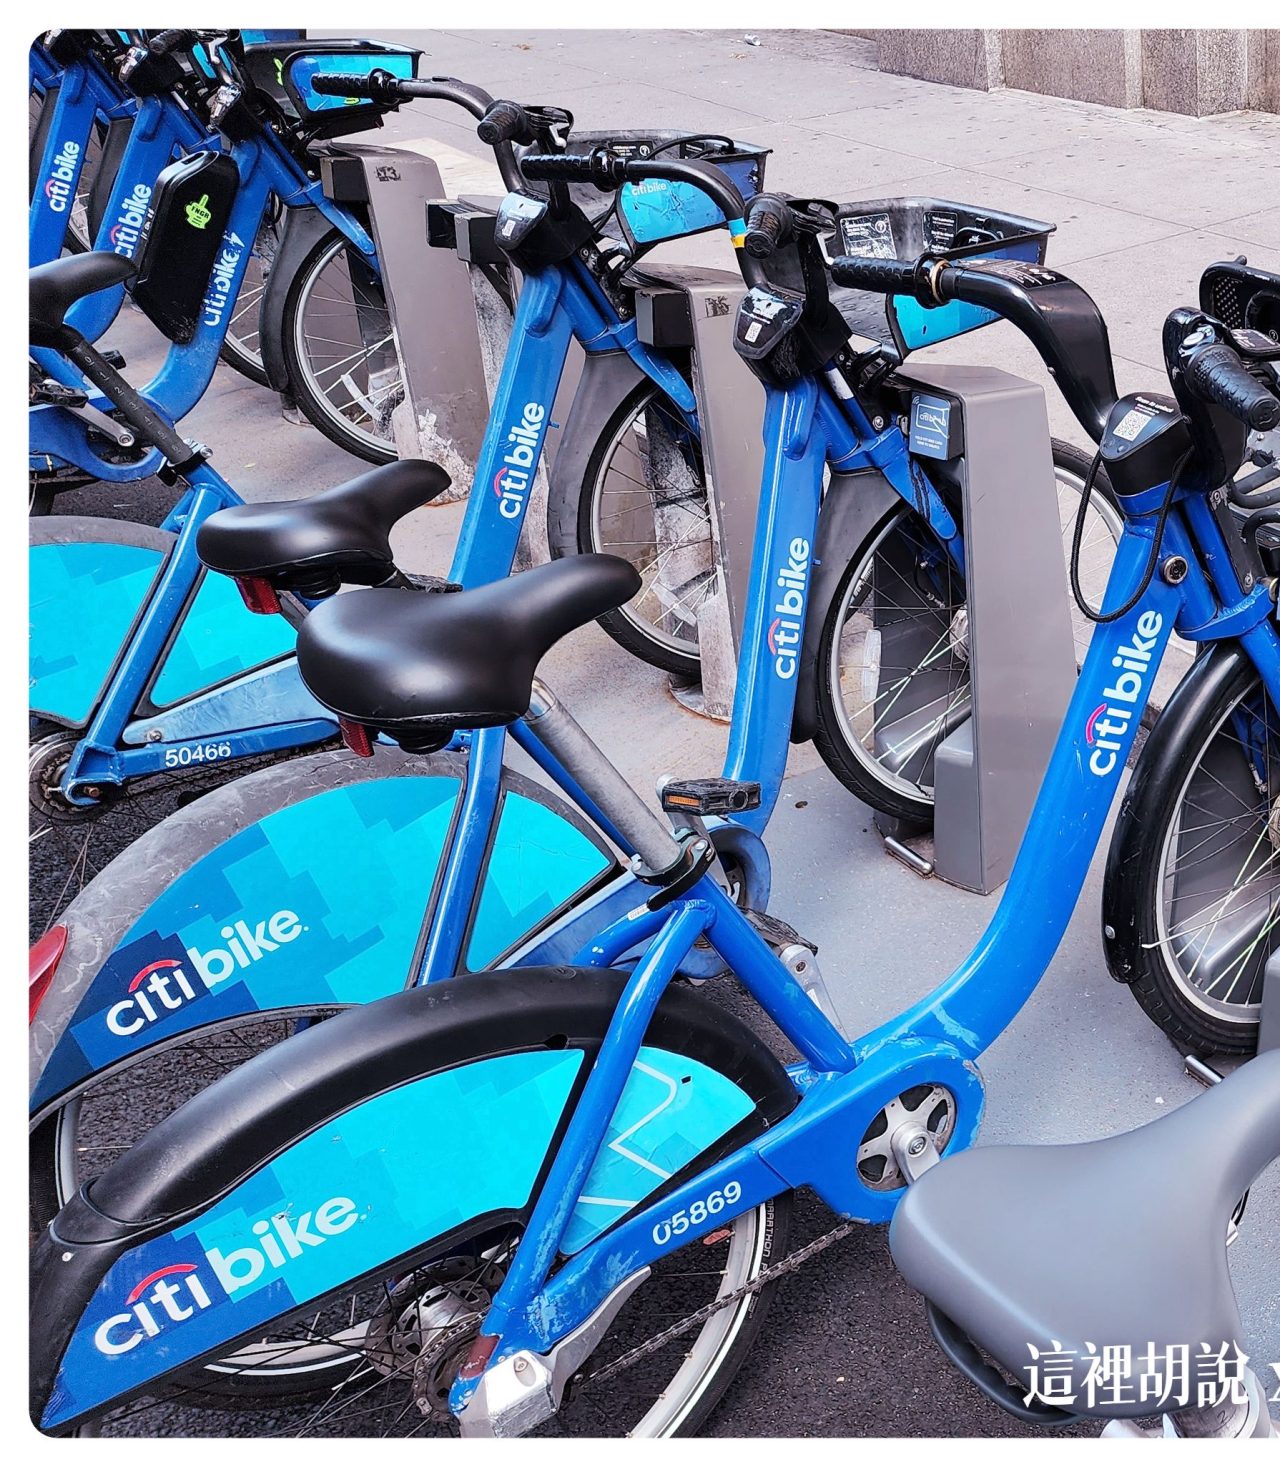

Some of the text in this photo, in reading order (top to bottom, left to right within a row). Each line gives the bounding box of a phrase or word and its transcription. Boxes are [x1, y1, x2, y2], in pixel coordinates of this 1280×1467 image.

[498, 402, 545, 518] citi bike
[772, 537, 810, 680] citi bike
[1088, 610, 1163, 777] citi bike
[165, 741, 232, 768] 50466
[106, 962, 197, 1036] citi
[652, 1180, 742, 1245] 05869
[94, 1267, 212, 1355] citi
